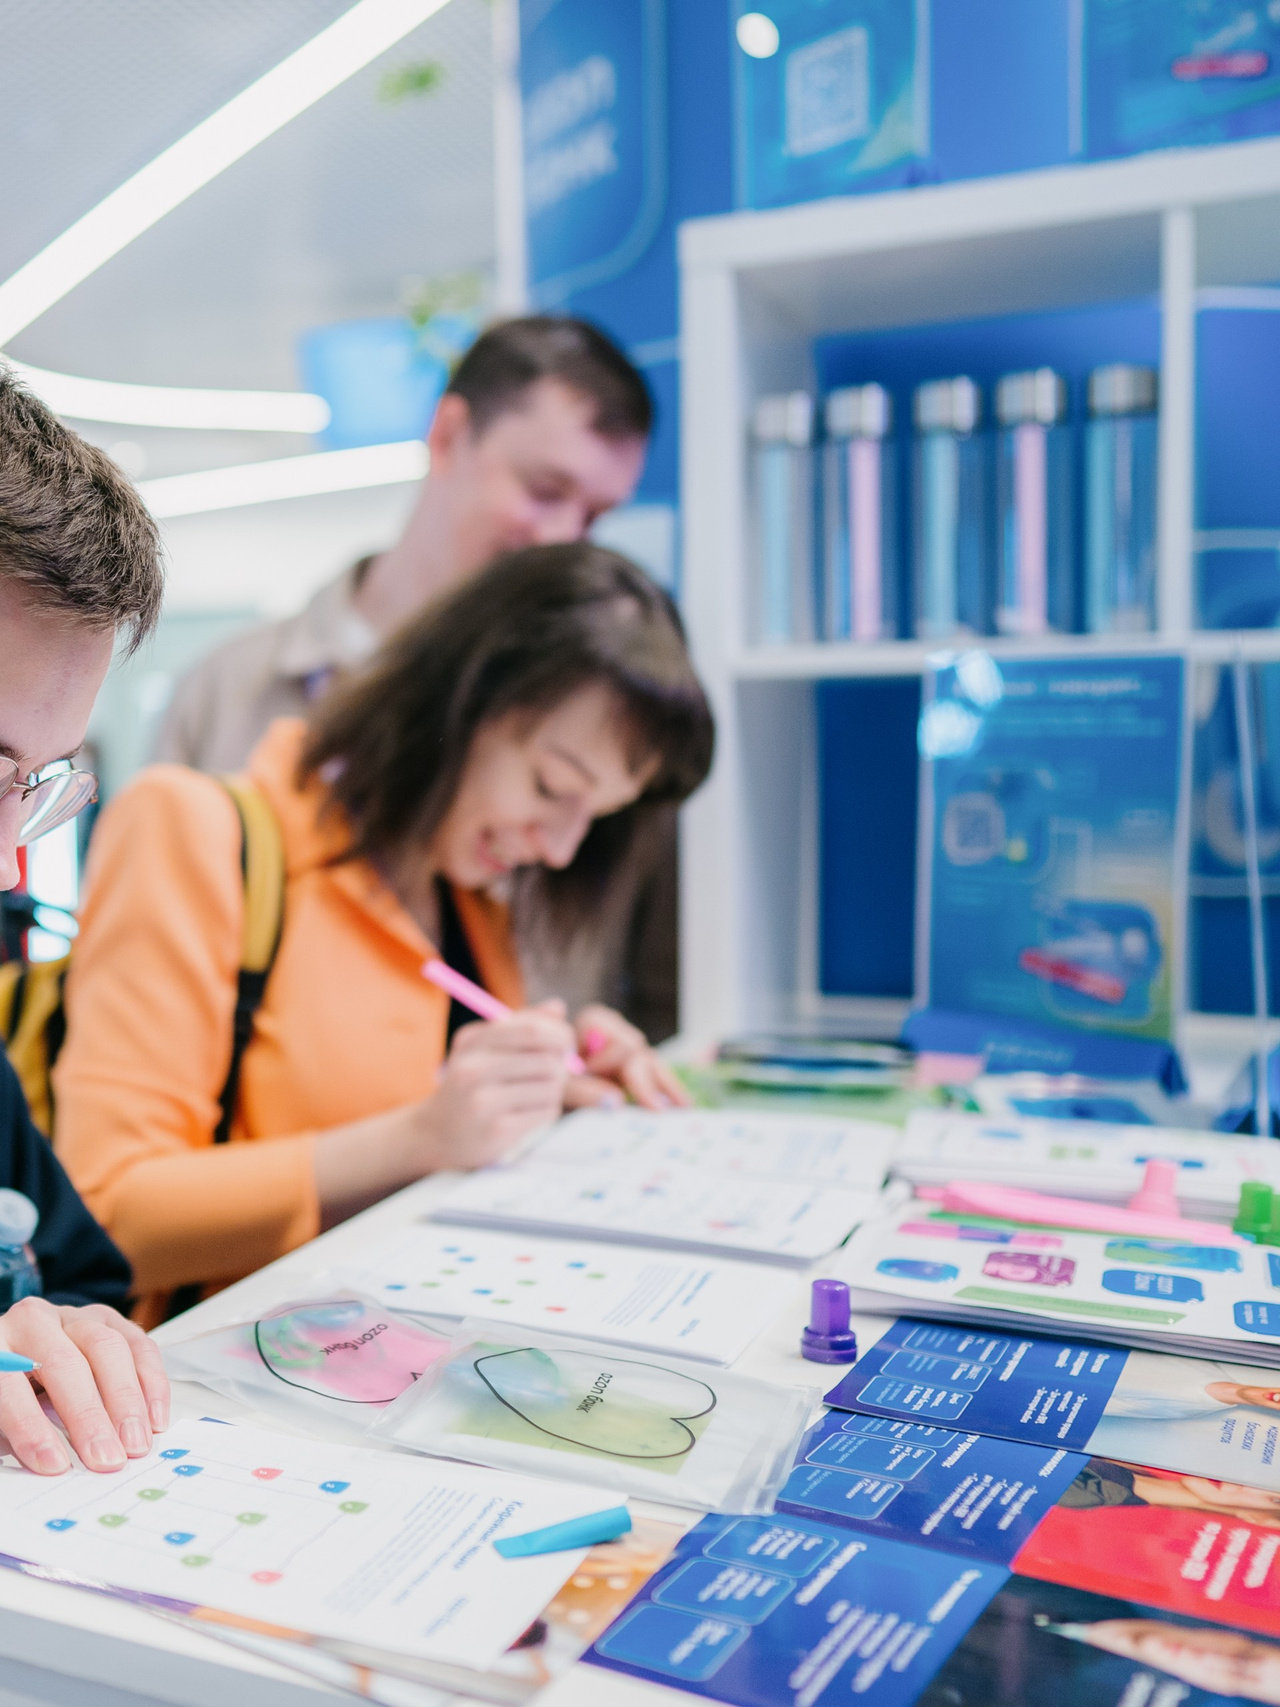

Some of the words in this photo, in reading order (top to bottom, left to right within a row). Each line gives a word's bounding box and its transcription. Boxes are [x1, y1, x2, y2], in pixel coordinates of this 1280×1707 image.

[352, 1323, 388, 1346] ozon
[319, 1342, 359, 1356] банк
[590, 1372, 613, 1395] ozon
[576, 1394, 604, 1414] банк
